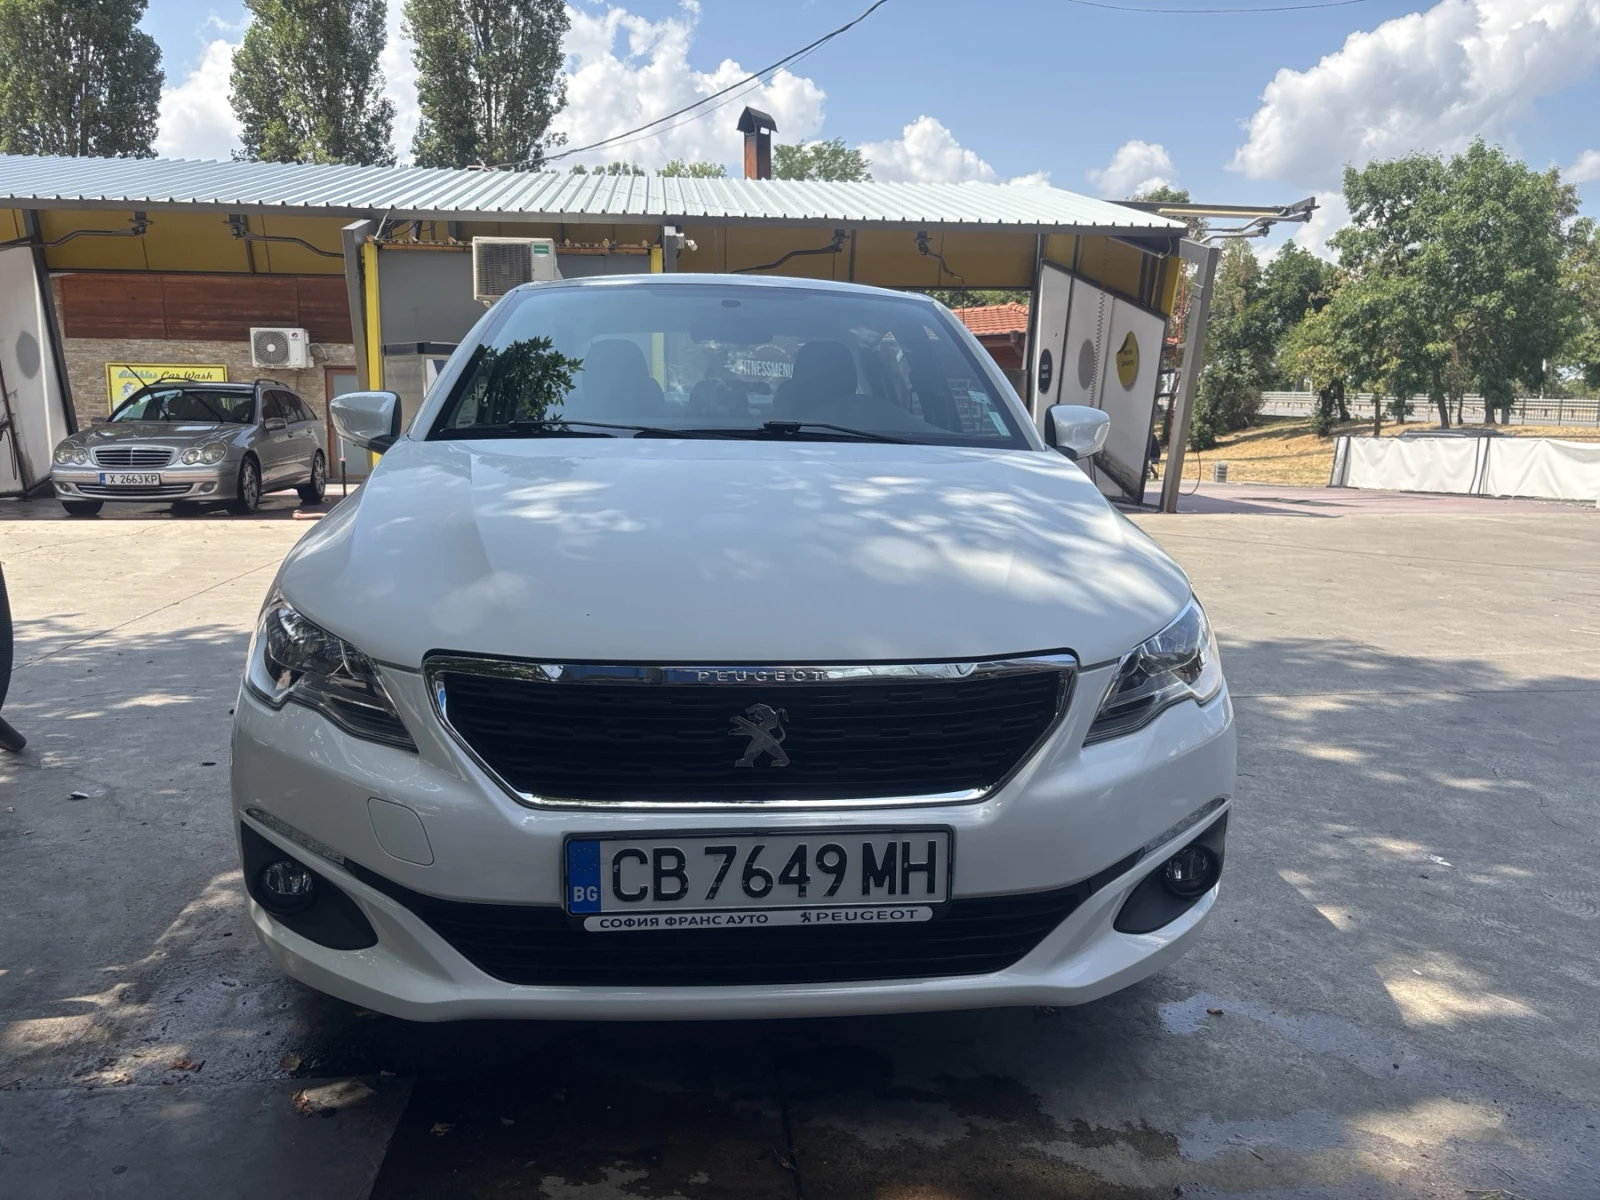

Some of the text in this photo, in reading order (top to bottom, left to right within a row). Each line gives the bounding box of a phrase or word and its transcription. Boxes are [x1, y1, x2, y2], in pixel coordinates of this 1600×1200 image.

[160, 371, 181, 380] Car
[184, 371, 214, 381] Wash
[109, 474, 116, 484] X
[697, 670, 826, 682] PEUGEOT
[573, 841, 937, 902] BG CB 7649 MH
[599, 913, 769, 929] СОФИЯ ФРАНС АУТО
[816, 909, 919, 922] PEUGEOT
